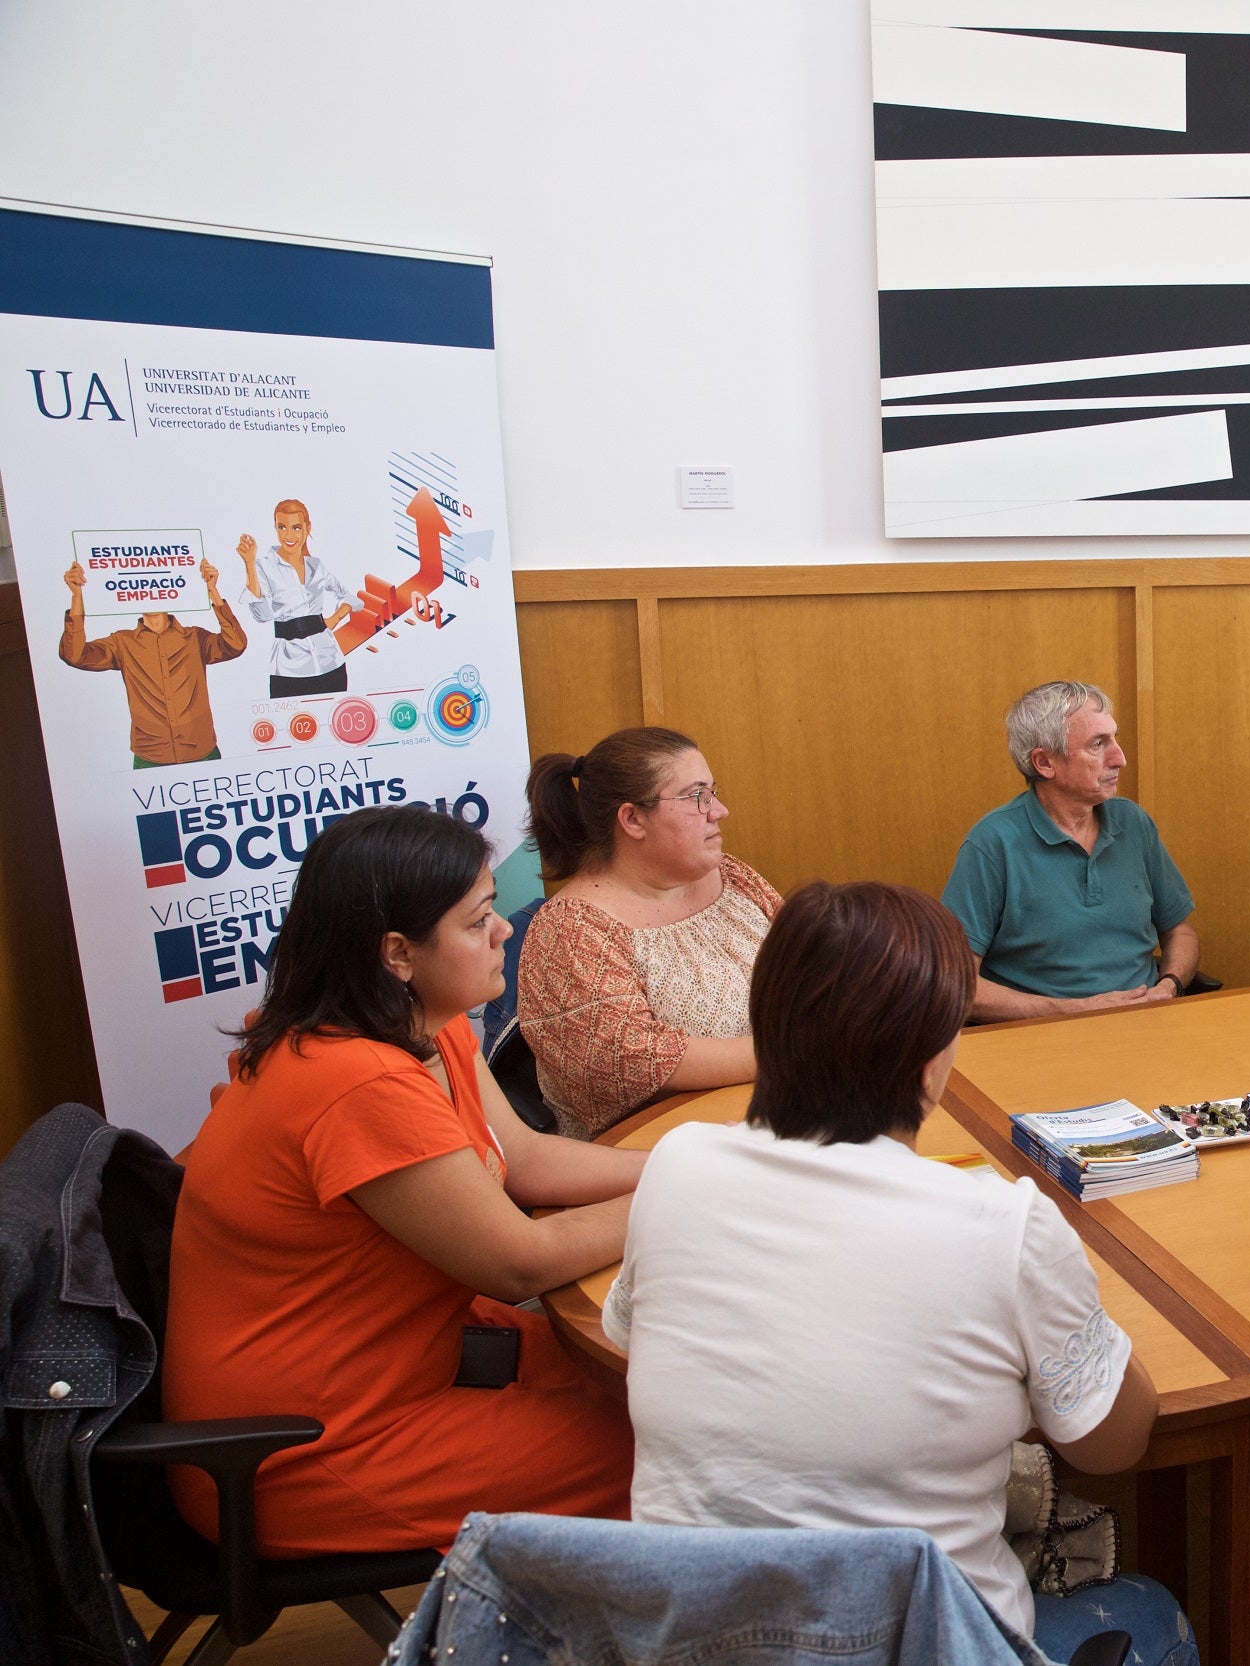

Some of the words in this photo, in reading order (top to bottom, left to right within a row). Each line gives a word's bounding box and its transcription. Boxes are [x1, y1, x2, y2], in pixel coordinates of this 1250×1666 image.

[143, 367, 226, 382] UNIVERSITAT
[229, 372, 297, 386] D'ALACANT
[26, 368, 126, 422] UA
[145, 382, 231, 396] UNIVERSIDAD
[235, 386, 250, 397] DE
[254, 388, 311, 400] ALICANTE
[147, 402, 213, 416] Vicerectorat
[215, 406, 275, 418] d'Estudiants
[277, 408, 281, 418] i
[284, 408, 329, 421] Ocupació
[149, 417, 226, 430] Vicerrectorado
[229, 419, 241, 431] de
[244, 420, 301, 432] Estudiantes
[302, 424, 309, 434] y
[312, 422, 346, 435] Empleo
[91, 545, 190, 557] ESTUDIANTS
[88, 556, 196, 569] ESTUDIANTES
[105, 575, 186, 591] OCUPACIÓ
[117, 589, 179, 602] EMPLEO
[462, 671, 476, 683] 05
[251, 700, 299, 716] 001.2462
[257, 727, 270, 738] 01
[295, 721, 311, 734] 02
[340, 711, 367, 734] 03
[397, 710, 411, 722] 04
[132, 757, 374, 810] VICERECTORAT
[179, 777, 407, 834] ESTUDIANTS
